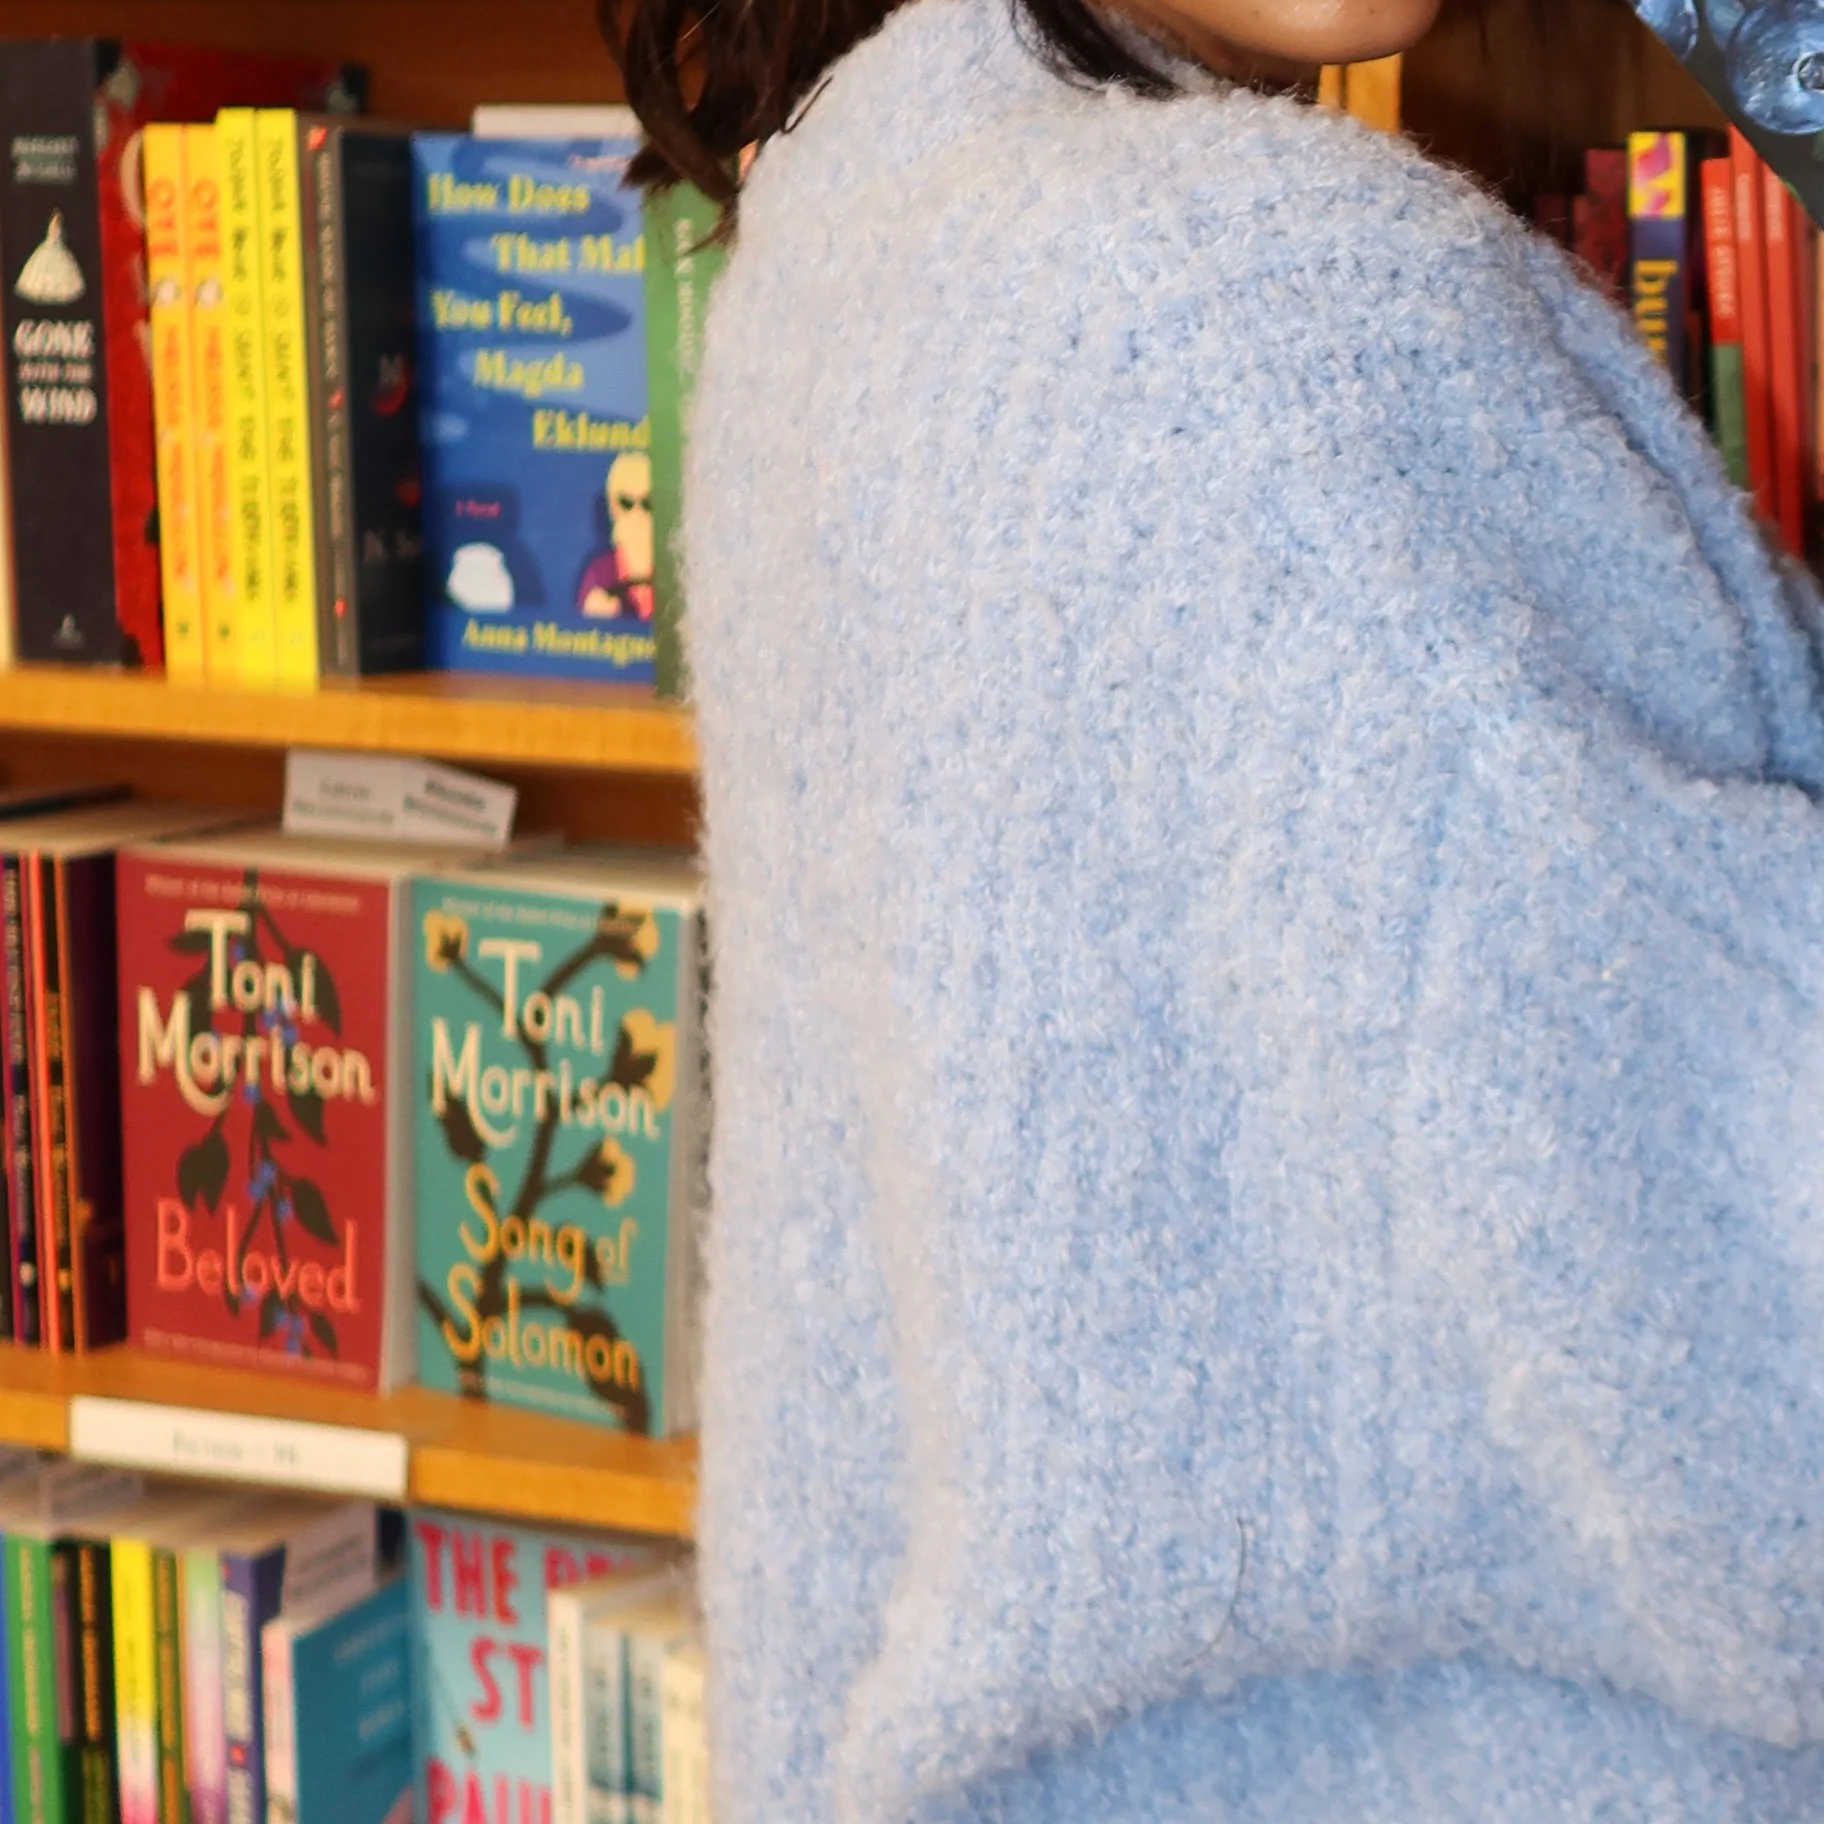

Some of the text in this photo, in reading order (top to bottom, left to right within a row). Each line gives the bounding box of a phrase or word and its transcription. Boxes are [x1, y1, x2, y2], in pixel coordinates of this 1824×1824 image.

[429, 174, 590, 215] How Does
[494, 233, 571, 273] That
[433, 291, 489, 331] You
[14, 320, 93, 358] GONE
[473, 351, 584, 395] Magda
[20, 386, 97, 424] WIND
[533, 410, 651, 451] Eklund
[462, 618, 525, 653] Anna
[185, 910, 317, 1024] Toni
[479, 938, 606, 1056] Toni
[136, 985, 376, 1117] Morrison
[431, 1016, 660, 1150] Morrison
[156, 1196, 360, 1316] Beloved
[458, 1163, 639, 1306] Song of
[441, 1260, 640, 1394] Solomon
